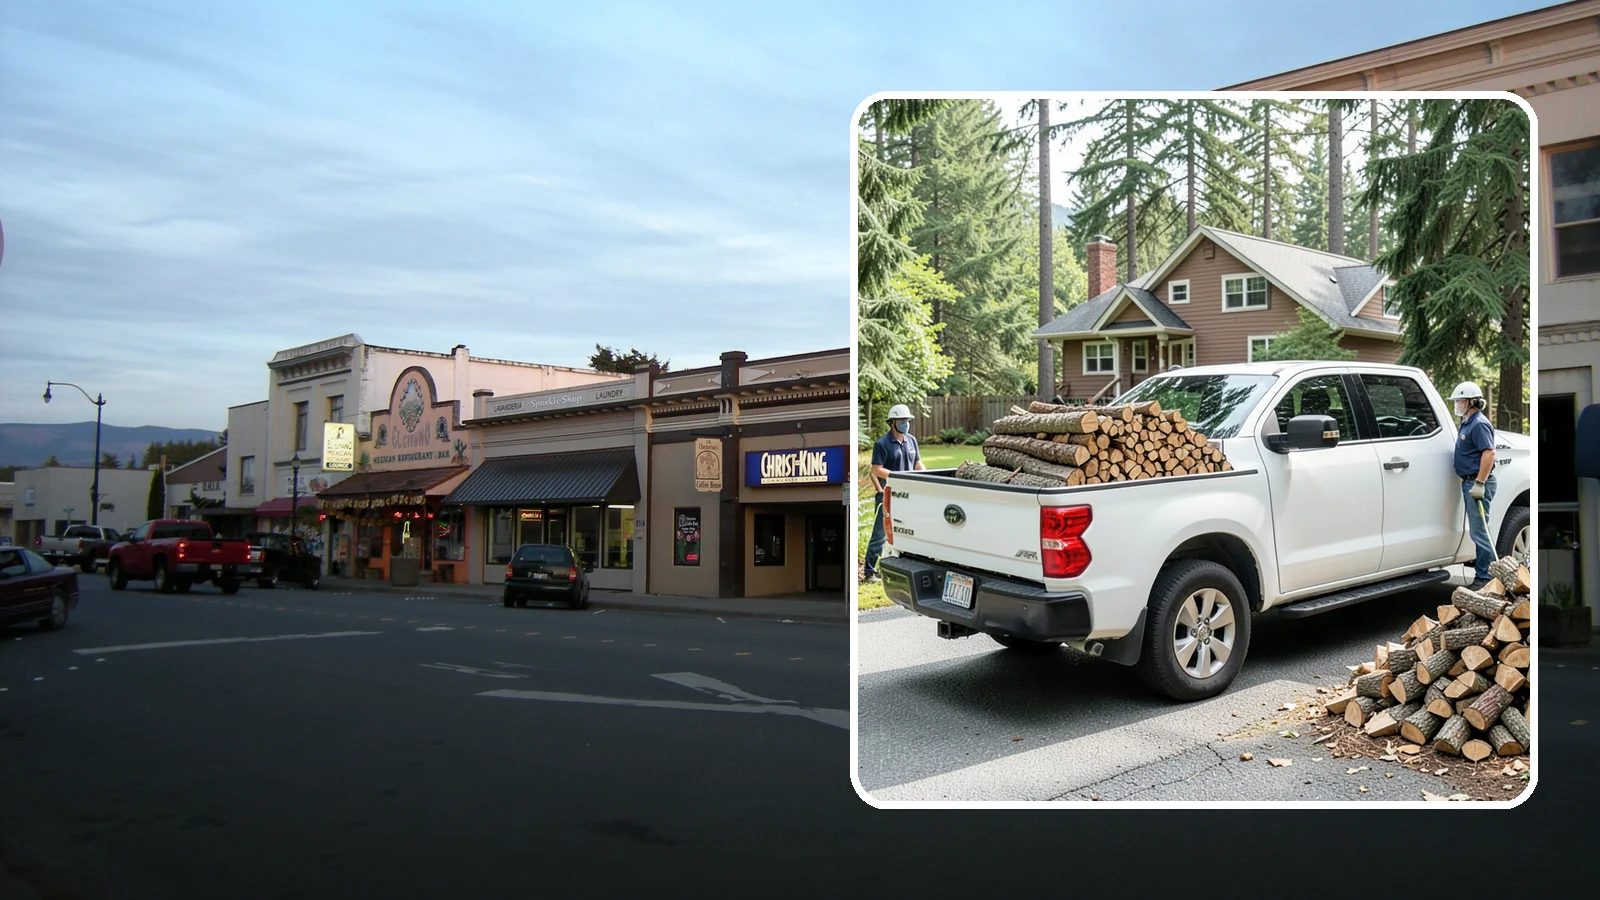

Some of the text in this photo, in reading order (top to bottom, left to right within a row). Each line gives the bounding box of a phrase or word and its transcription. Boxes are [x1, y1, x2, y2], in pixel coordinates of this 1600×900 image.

[561, 394, 582, 405] Shop
[596, 389, 623, 400] LAUNDRY
[494, 402, 522, 412] LAVANDERIA
[397, 451, 433, 462] RESTAURANT
[437, 450, 450, 459] BAR
[761, 450, 828, 478] CHRIST KING
